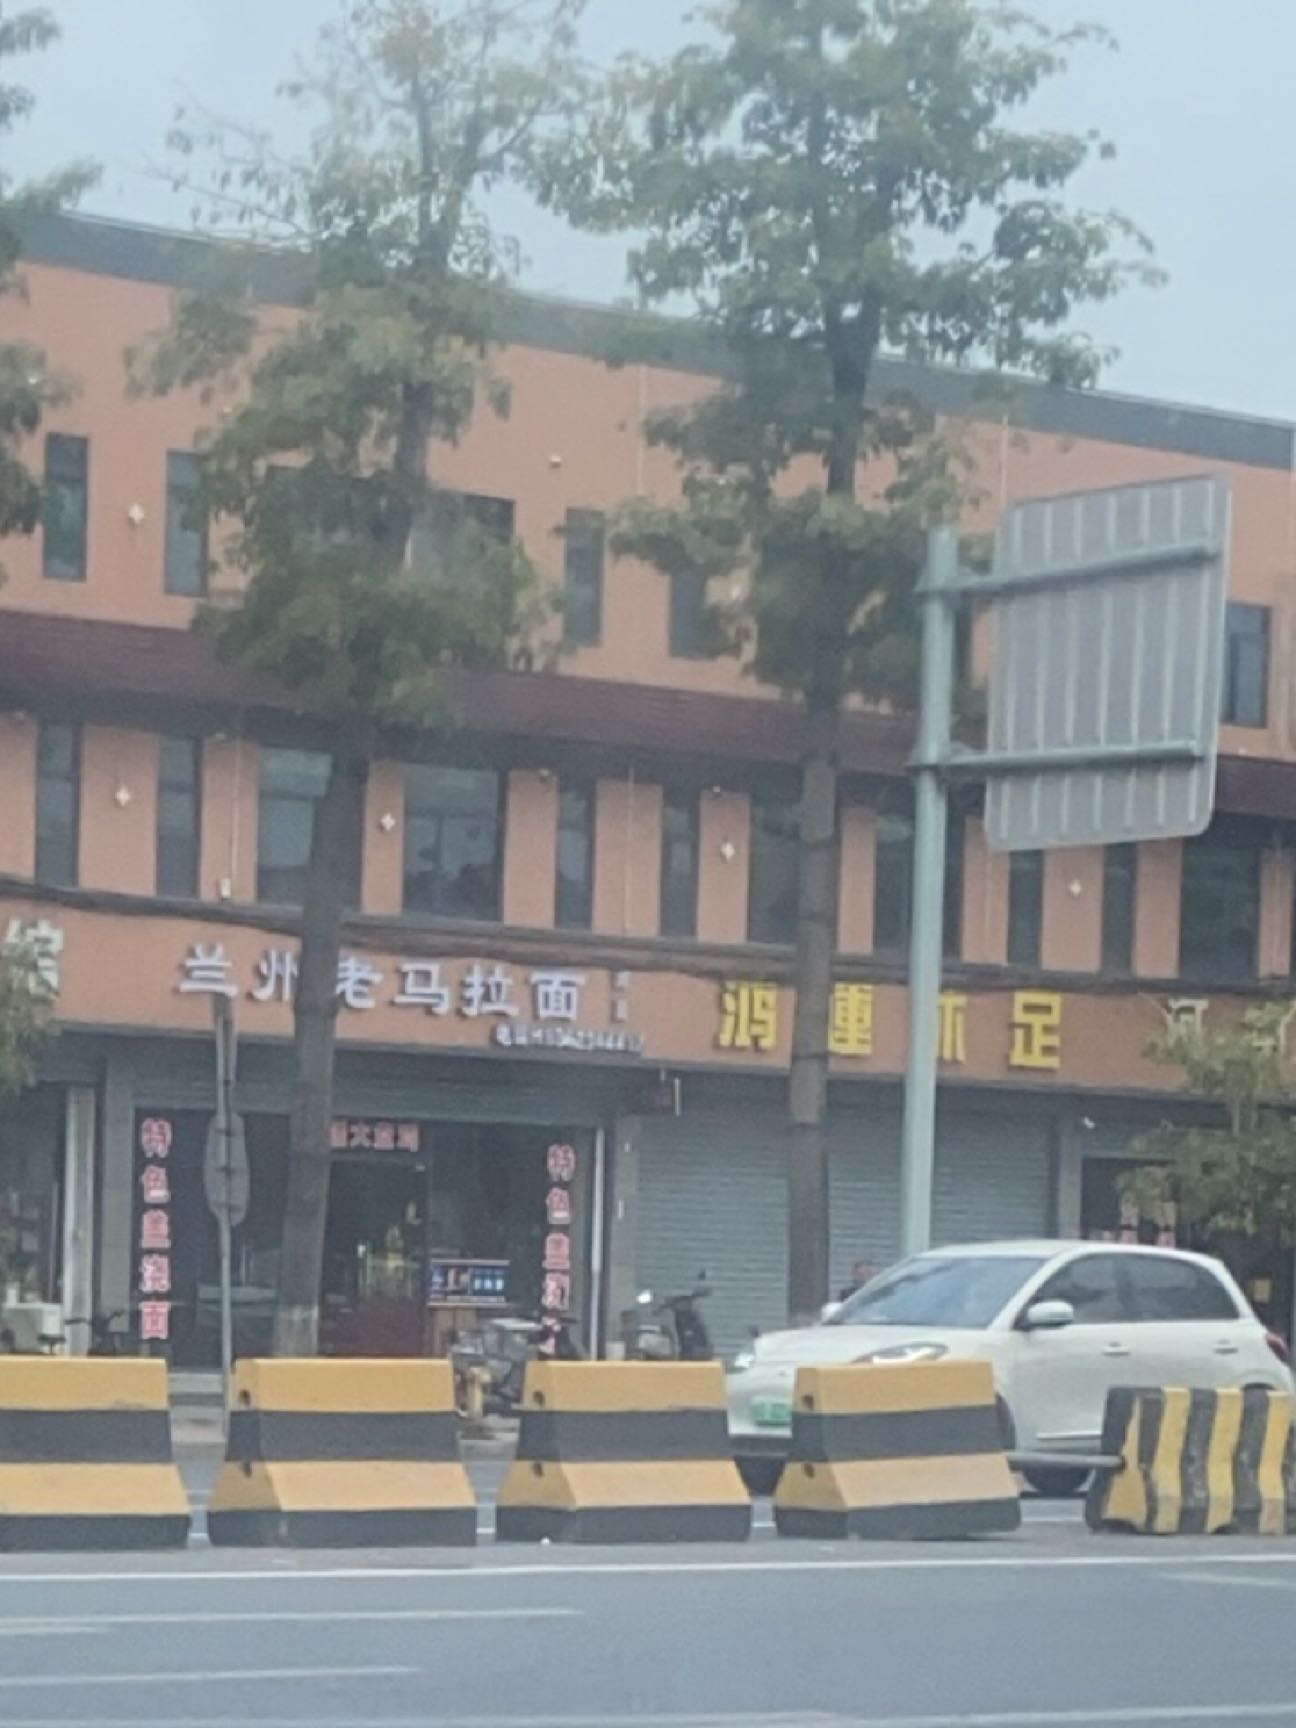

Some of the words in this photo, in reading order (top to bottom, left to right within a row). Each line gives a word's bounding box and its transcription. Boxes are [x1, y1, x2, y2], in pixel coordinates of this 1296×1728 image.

[178, 943, 586, 1022] 兰州老马拉面
